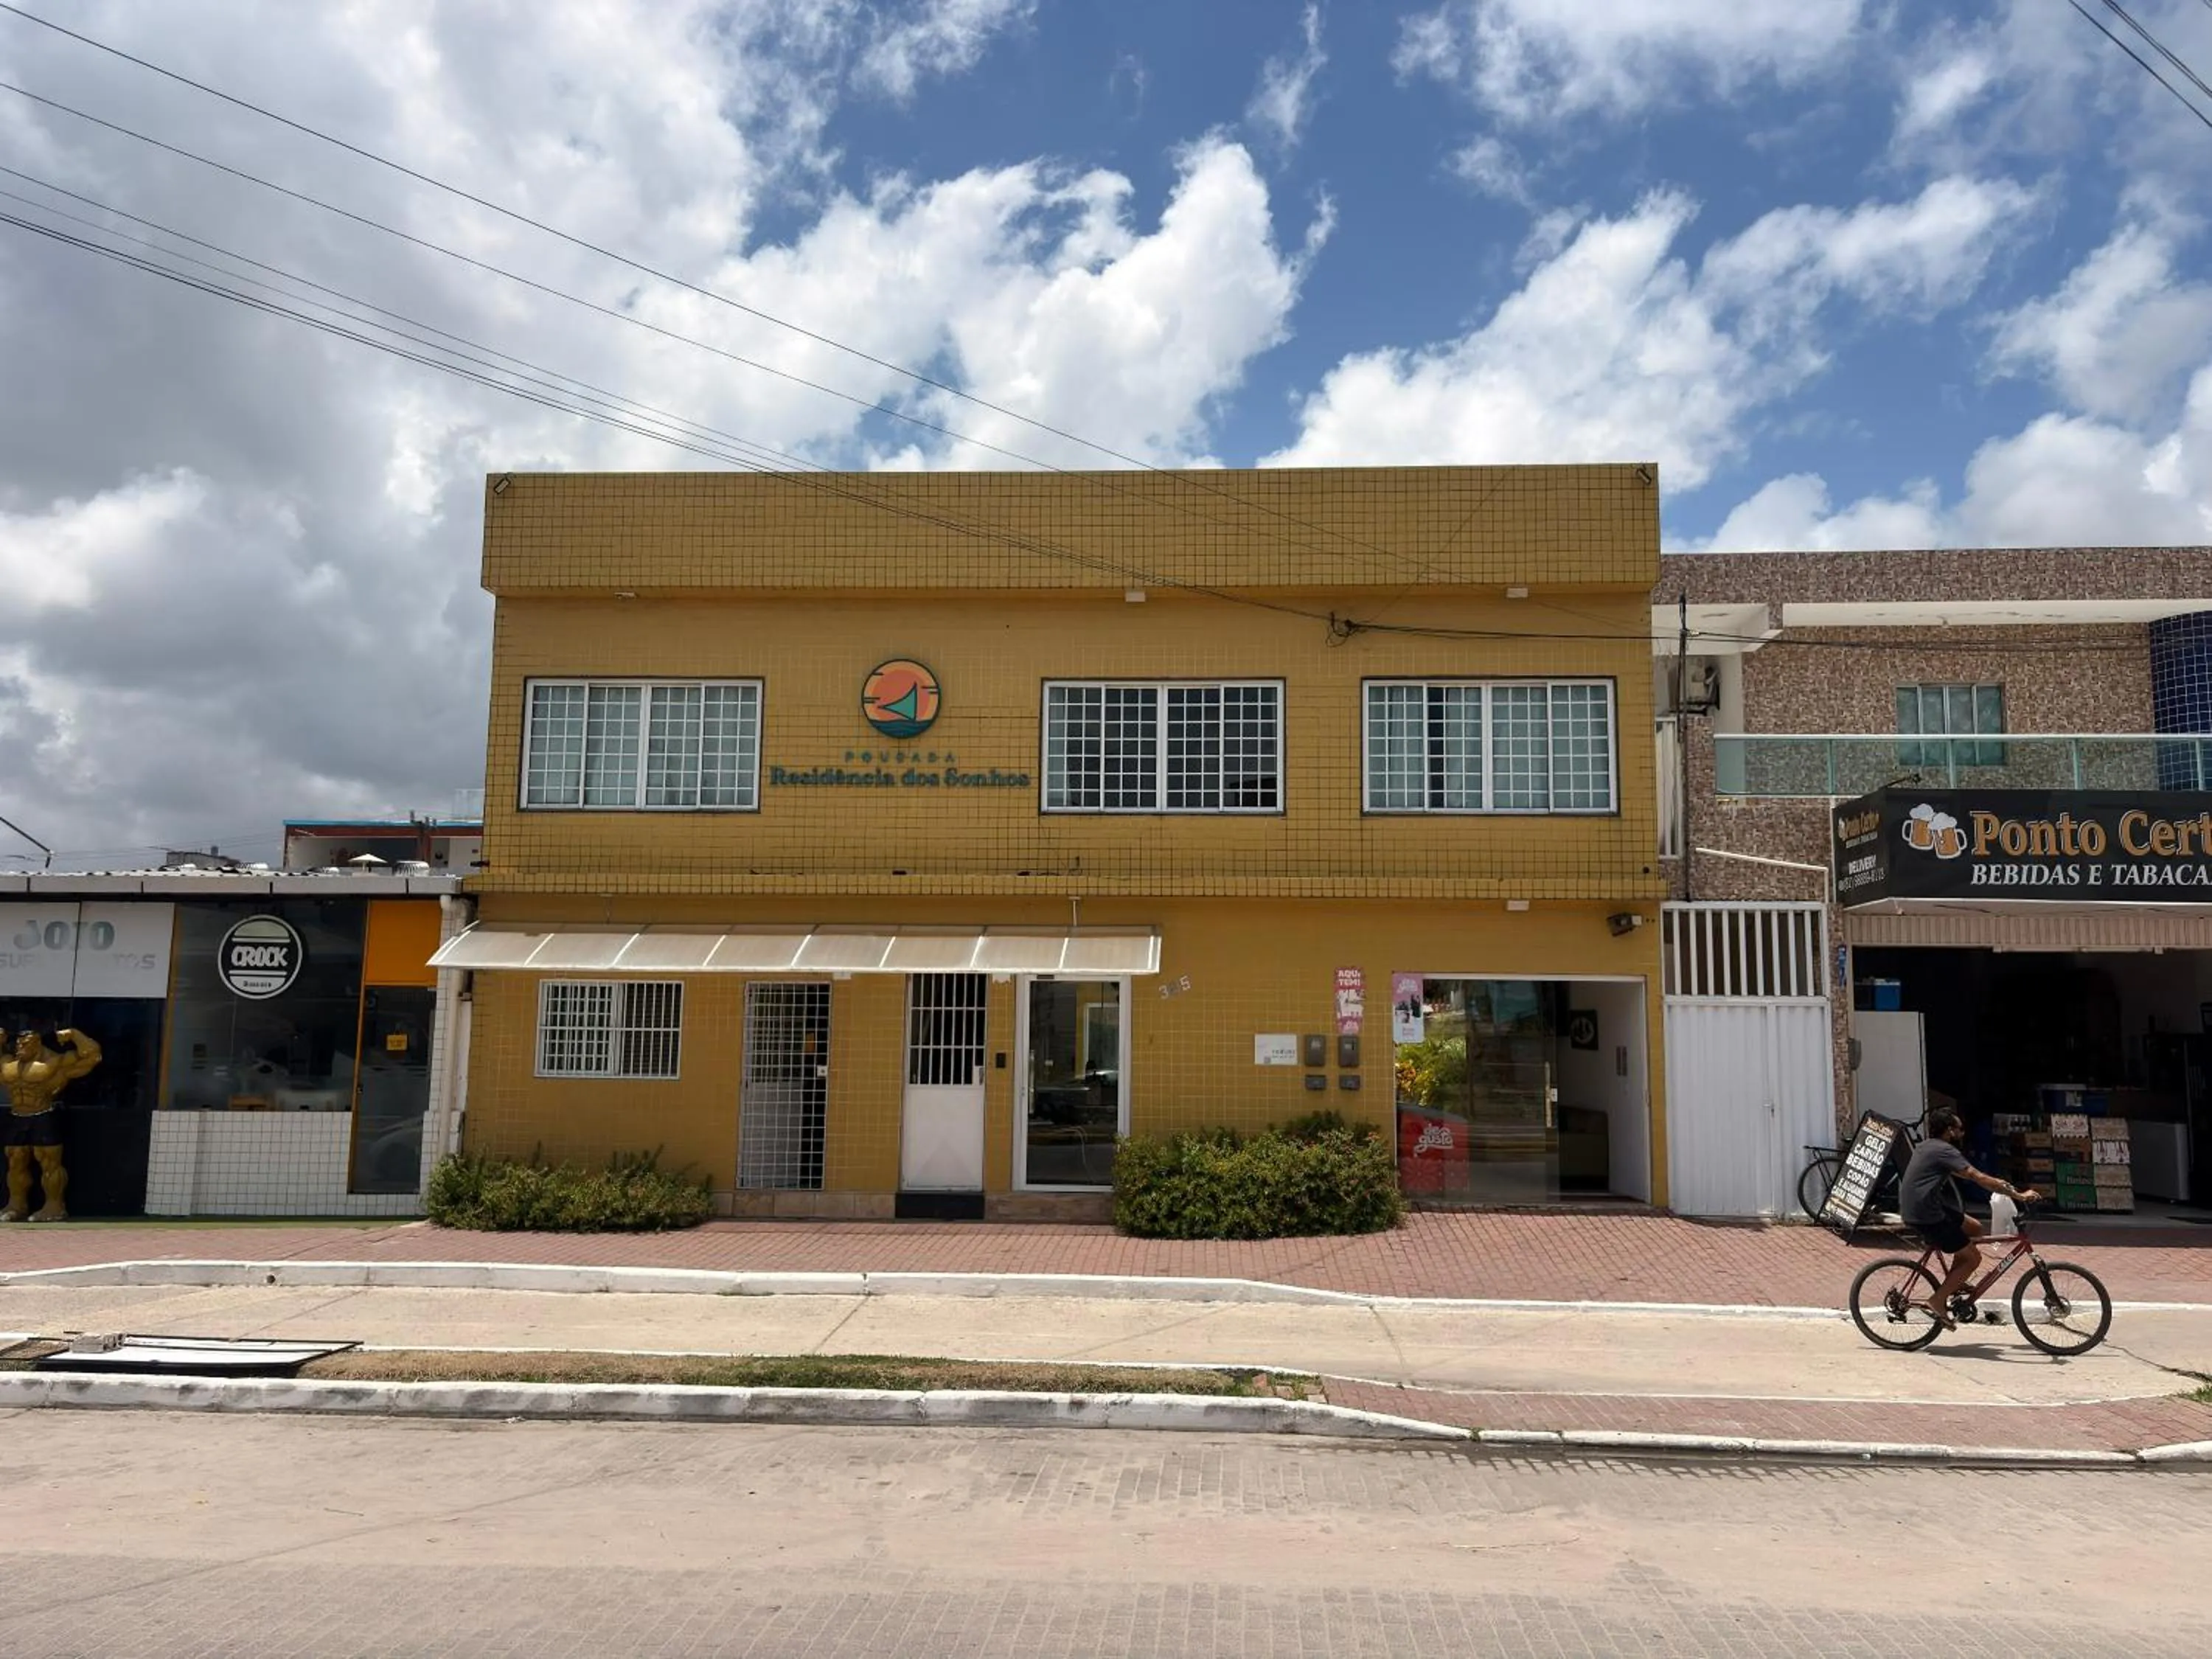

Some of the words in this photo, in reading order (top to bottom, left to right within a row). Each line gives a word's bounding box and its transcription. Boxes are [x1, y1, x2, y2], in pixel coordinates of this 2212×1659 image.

[901, 768, 939, 786] dos
[944, 768, 1031, 787] Sonhos
[1970, 810, 2107, 857] Ponto
[1970, 864, 2080, 886] BEBIDAS
[2087, 864, 2103, 886] E
[2111, 864, 2212, 886] TABACA
[231, 946, 288, 967] CROCK
[1865, 1135, 1885, 1152] GELO
